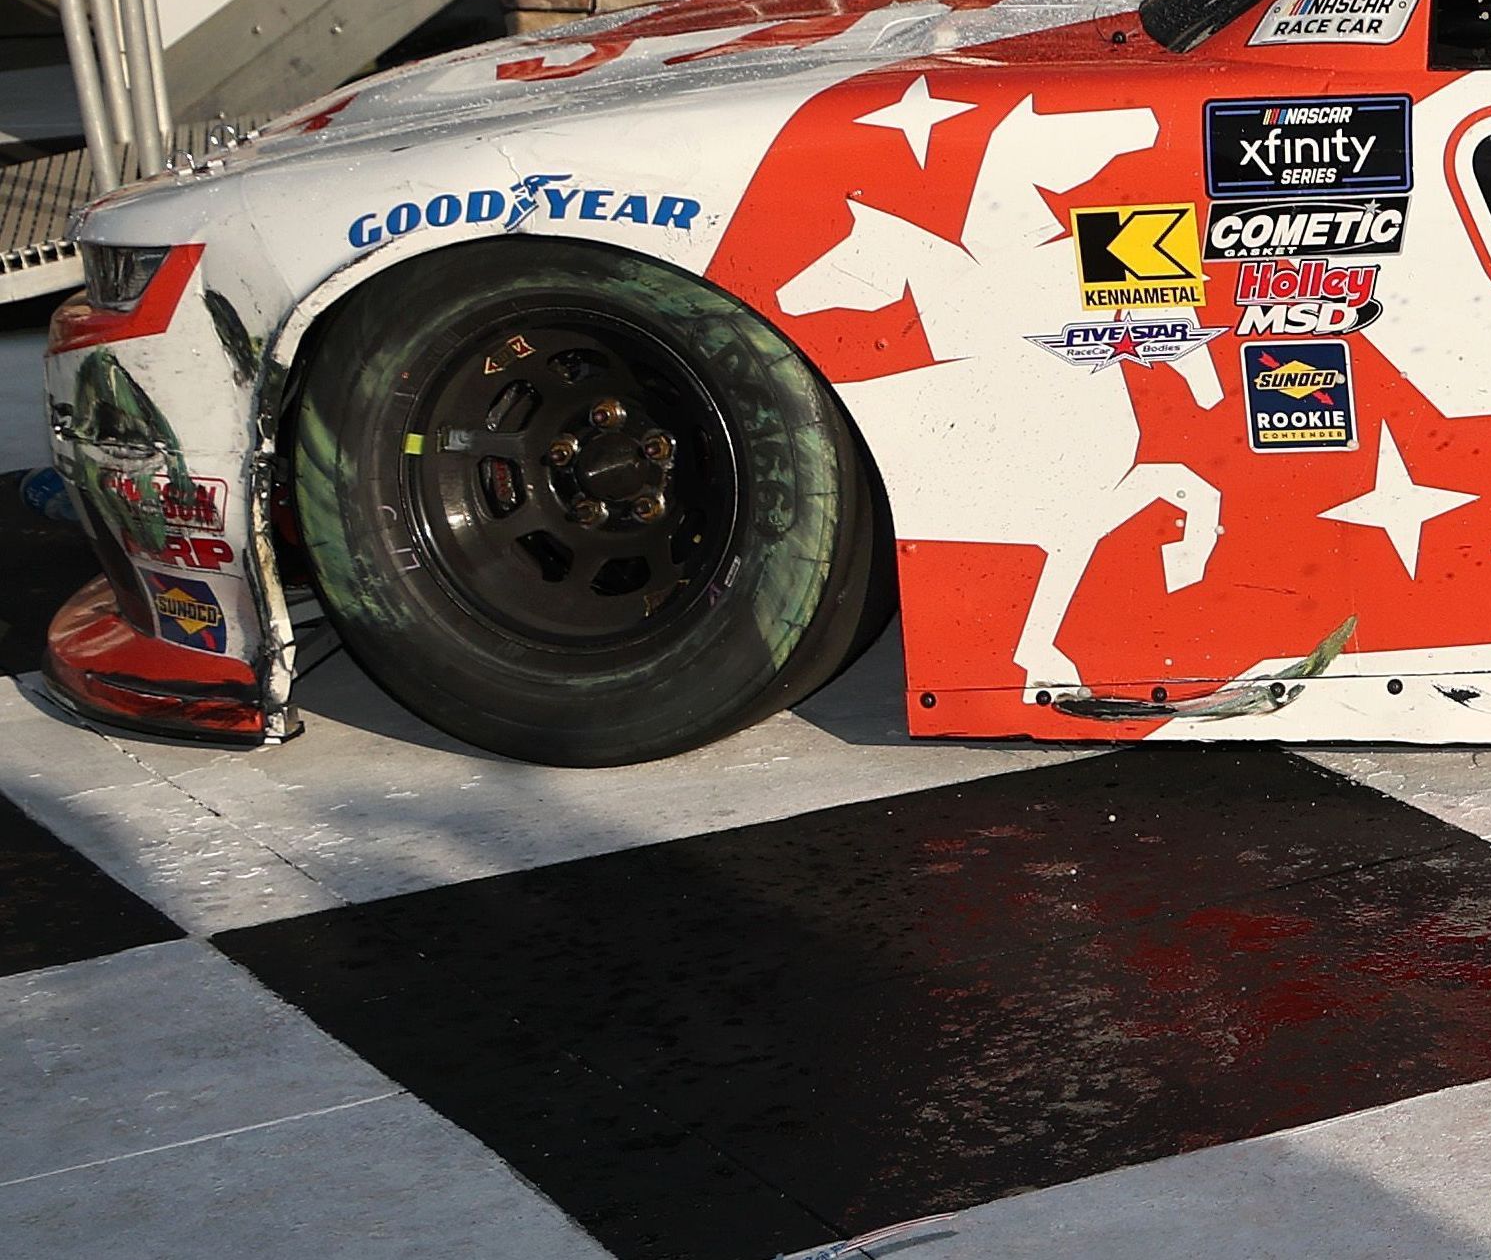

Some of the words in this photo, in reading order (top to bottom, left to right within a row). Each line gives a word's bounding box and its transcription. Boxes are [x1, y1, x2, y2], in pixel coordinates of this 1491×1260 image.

[1274, 18, 1332, 37] RACE
[1336, 17, 1383, 35] CAR
[1284, 107, 1352, 124] NASCAR
[1240, 128, 1376, 175] xfinity
[1281, 168, 1337, 185] SERIES
[1211, 209, 1402, 249] COMETIC
[1224, 246, 1298, 257] GASKET
[1238, 261, 1377, 307] Holley
[1085, 287, 1200, 306] KENNAMETAL
[1237, 303, 1357, 335] MSD
[1066, 327, 1121, 346] FIVE
[1131, 324, 1189, 341] STAR
[1259, 371, 1337, 388] SUNOCO
[1257, 410, 1345, 428] ROOKIE
[1263, 431, 1343, 440] CONTENDER
[157, 597, 217, 624] SUNOCO
